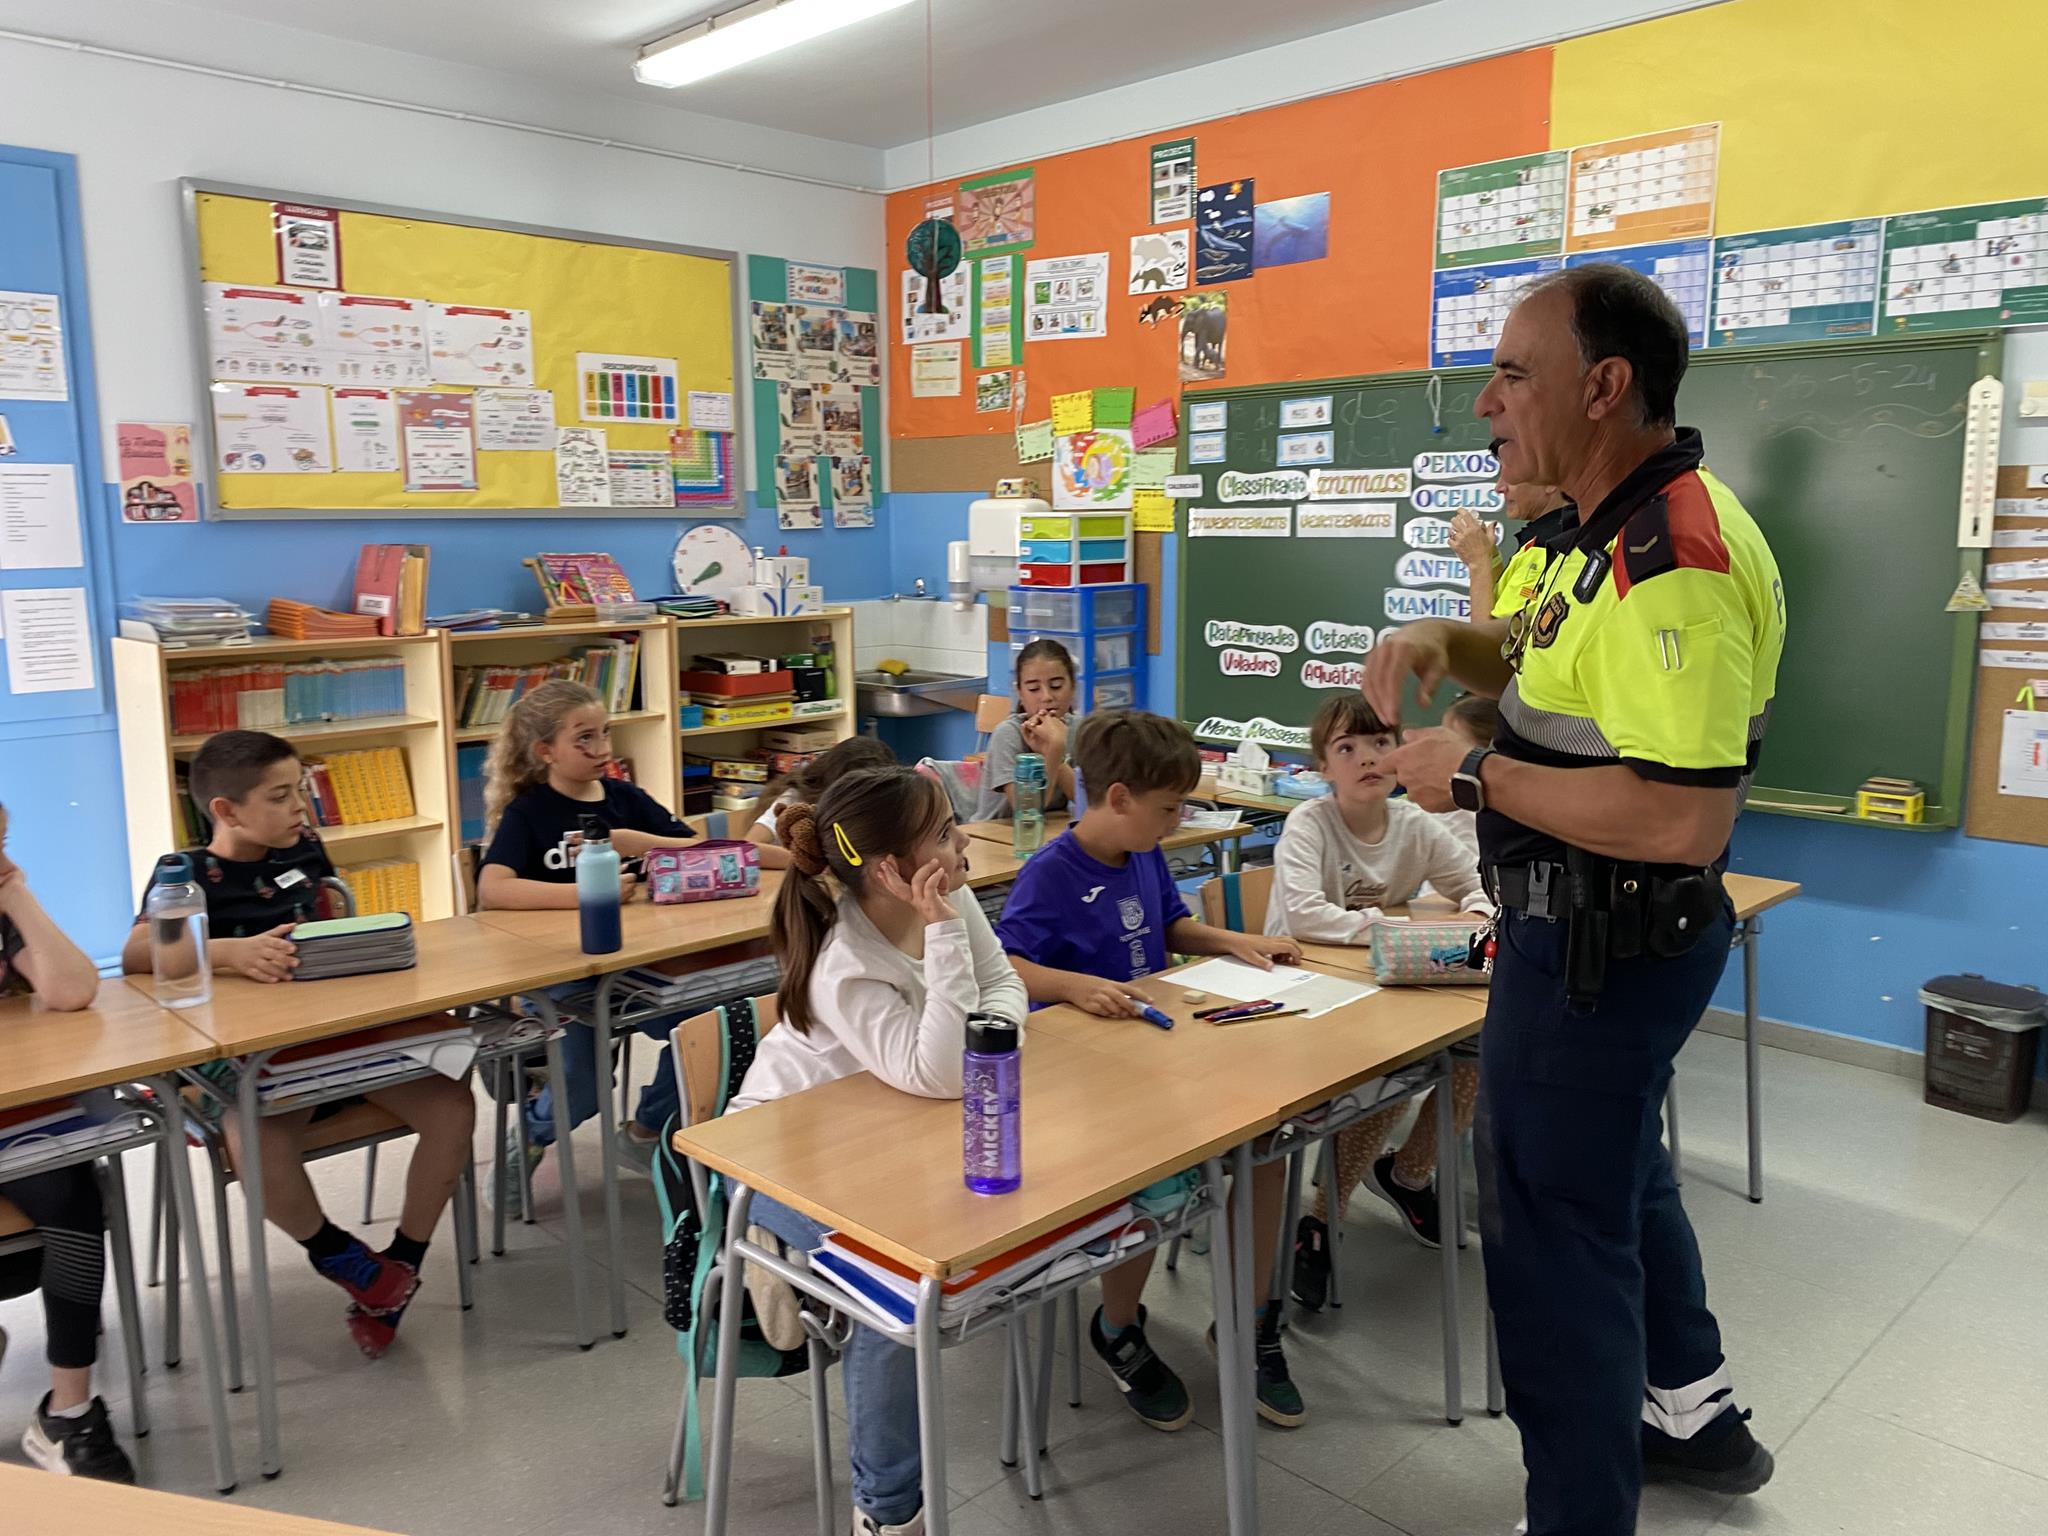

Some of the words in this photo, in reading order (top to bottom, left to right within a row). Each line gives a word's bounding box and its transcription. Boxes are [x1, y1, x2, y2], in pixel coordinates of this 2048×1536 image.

[1418, 454, 1497, 474] PEIXOS
[1416, 489, 1500, 508] OCELLS
[1404, 559, 1469, 579] ANFIB
[1387, 593, 1471, 616] MAMÍFE
[1223, 652, 1279, 674] Voladors
[1304, 664, 1362, 685] Aquàtic
[982, 1088, 1000, 1169] MICKEY
